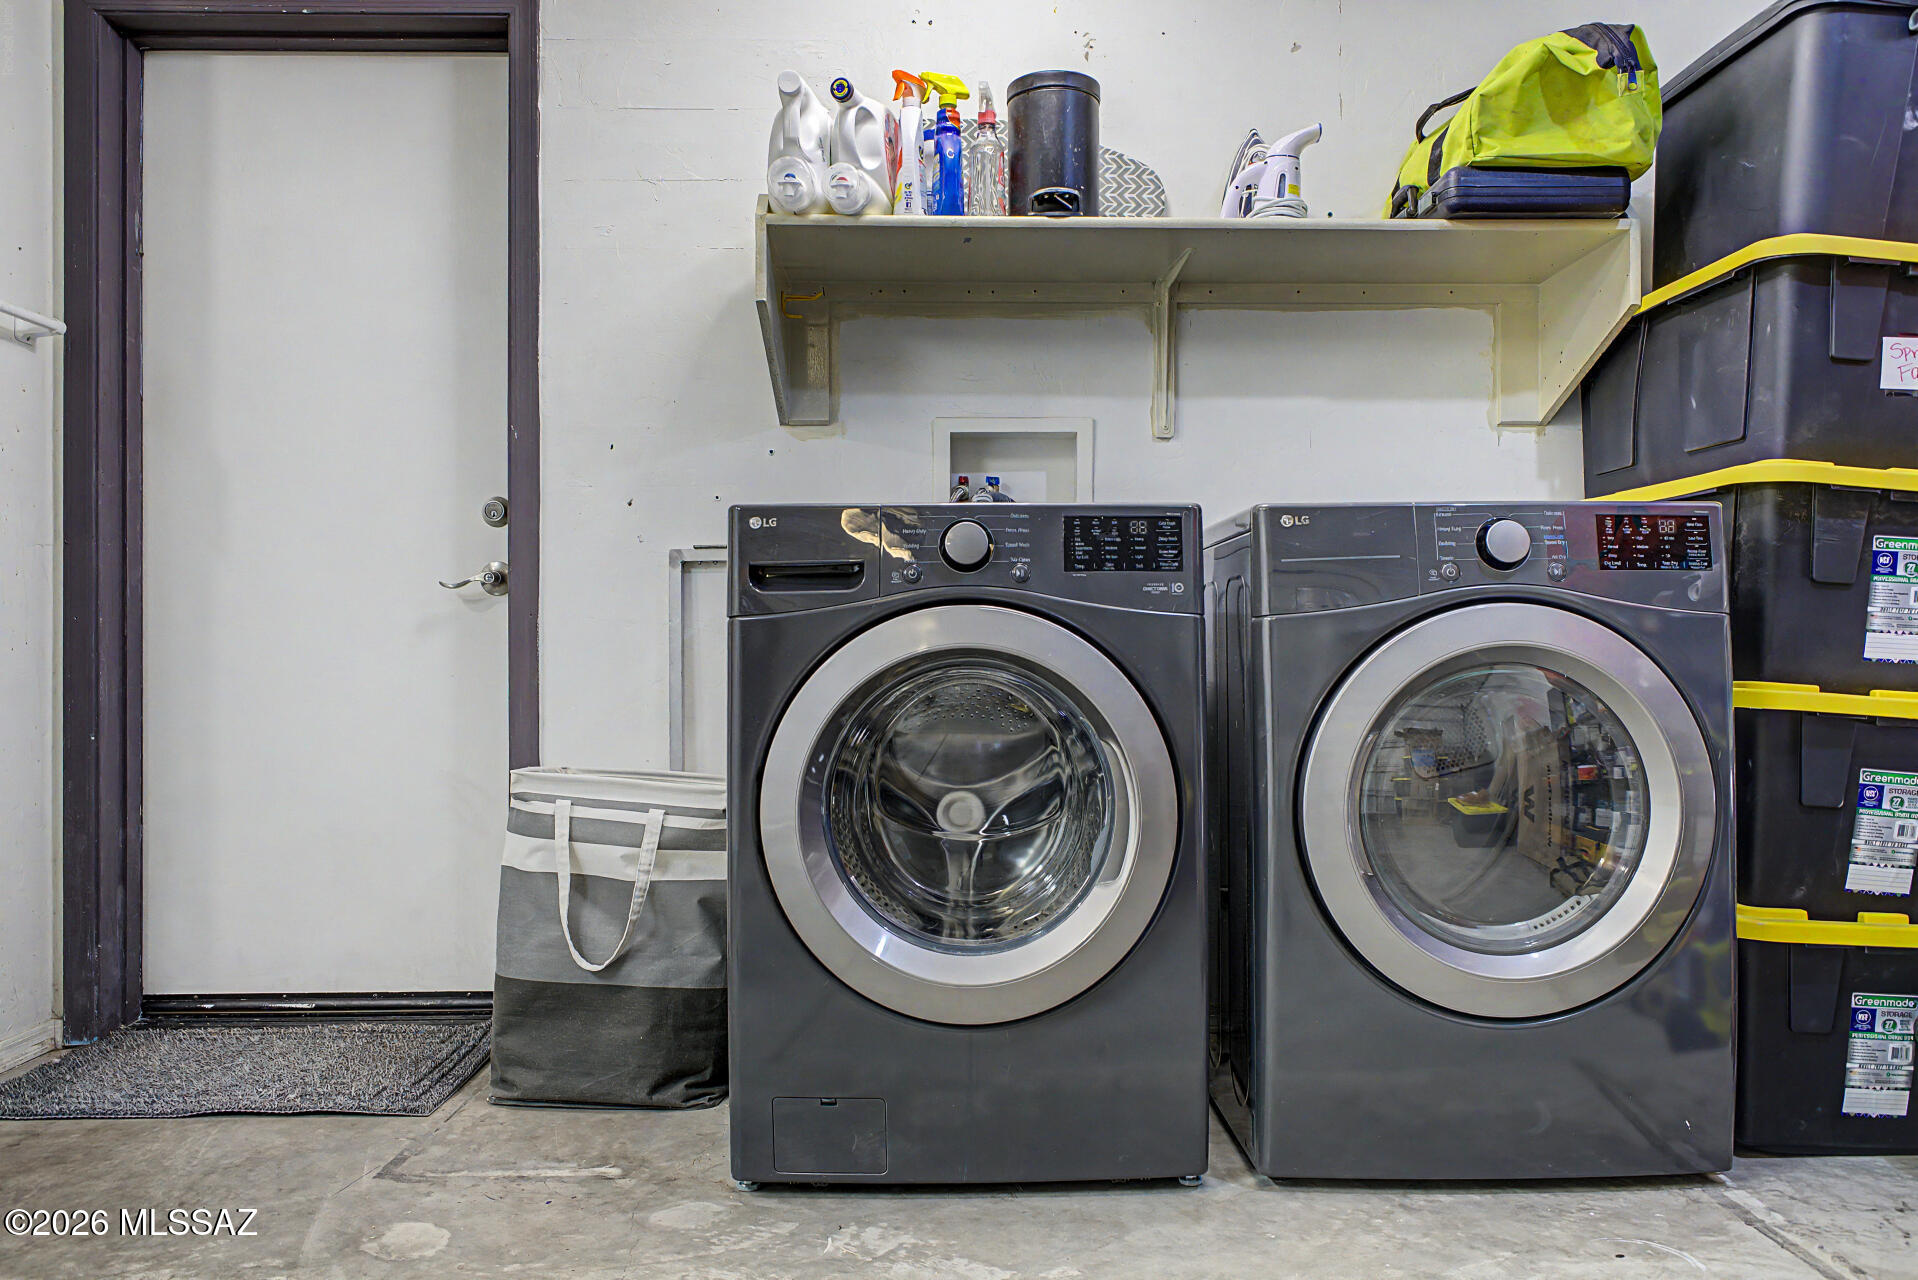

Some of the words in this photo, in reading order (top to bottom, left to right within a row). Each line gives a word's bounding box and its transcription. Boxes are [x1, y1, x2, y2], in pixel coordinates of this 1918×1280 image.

[1876, 538, 1918, 550] Greenm
[1903, 553, 1918, 561] STO
[1863, 772, 1918, 785] Greenmad
[1855, 996, 1915, 1008] Greenmade
[1881, 1010, 1913, 1018] STORAGE
